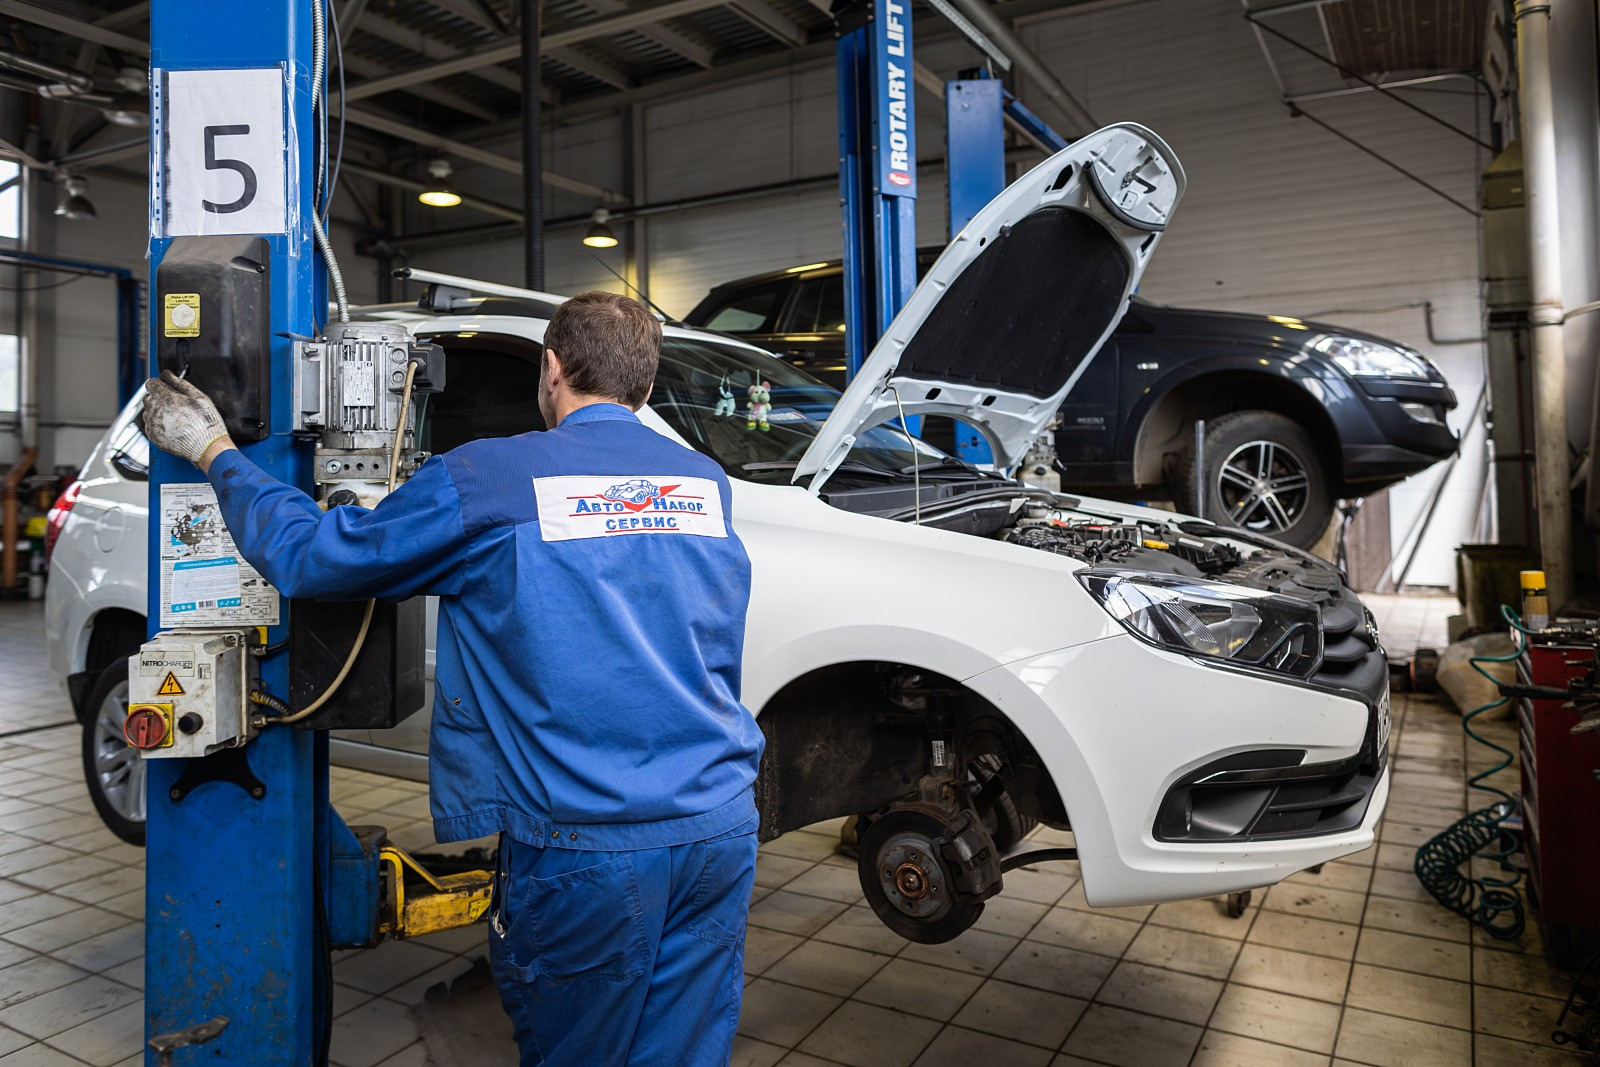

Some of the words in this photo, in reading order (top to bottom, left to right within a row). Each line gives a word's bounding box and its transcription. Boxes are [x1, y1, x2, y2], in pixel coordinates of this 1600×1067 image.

[886, 0, 905, 57] LIFT
[888, 61, 909, 171] ROTARY
[202, 124, 257, 214] 5
[605, 517, 677, 530] СЕРВИС
